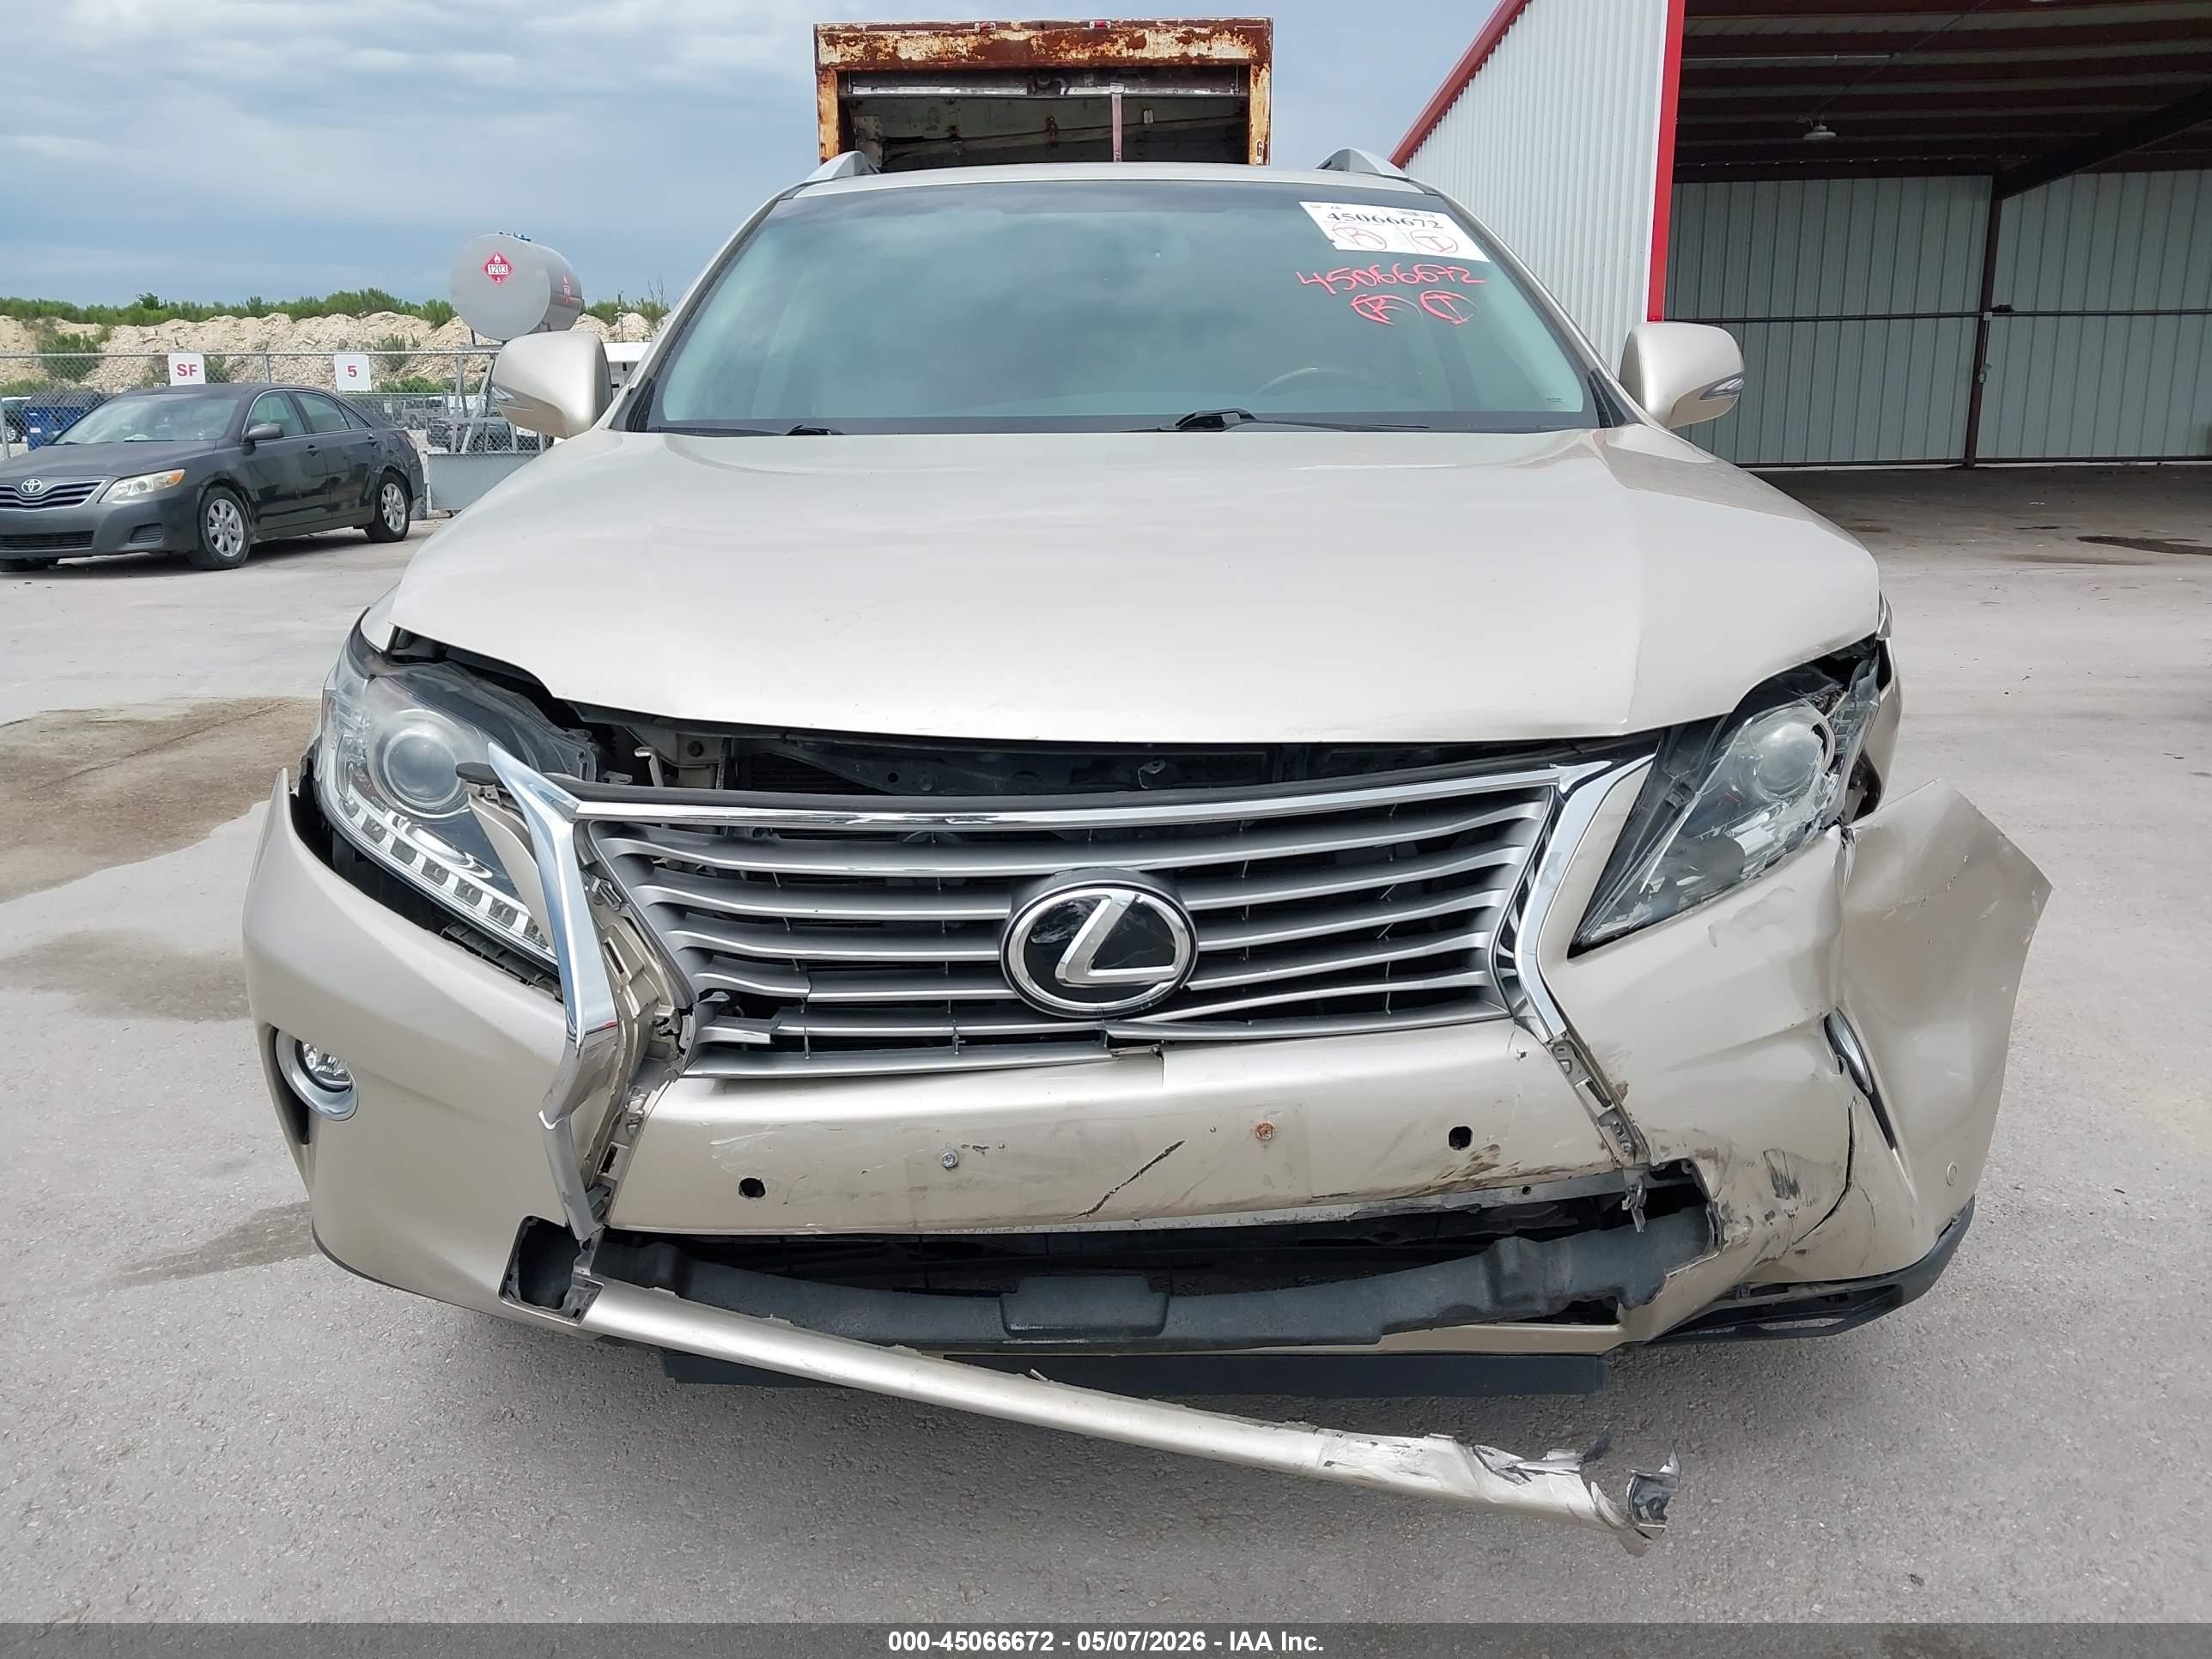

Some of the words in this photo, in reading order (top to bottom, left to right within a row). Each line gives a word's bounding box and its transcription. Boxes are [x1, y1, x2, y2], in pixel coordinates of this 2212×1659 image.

[1328, 212, 1443, 228] 45066672
[1297, 263, 1486, 295] 45066672
[177, 364, 198, 376] SF
[348, 365, 357, 377] 5
